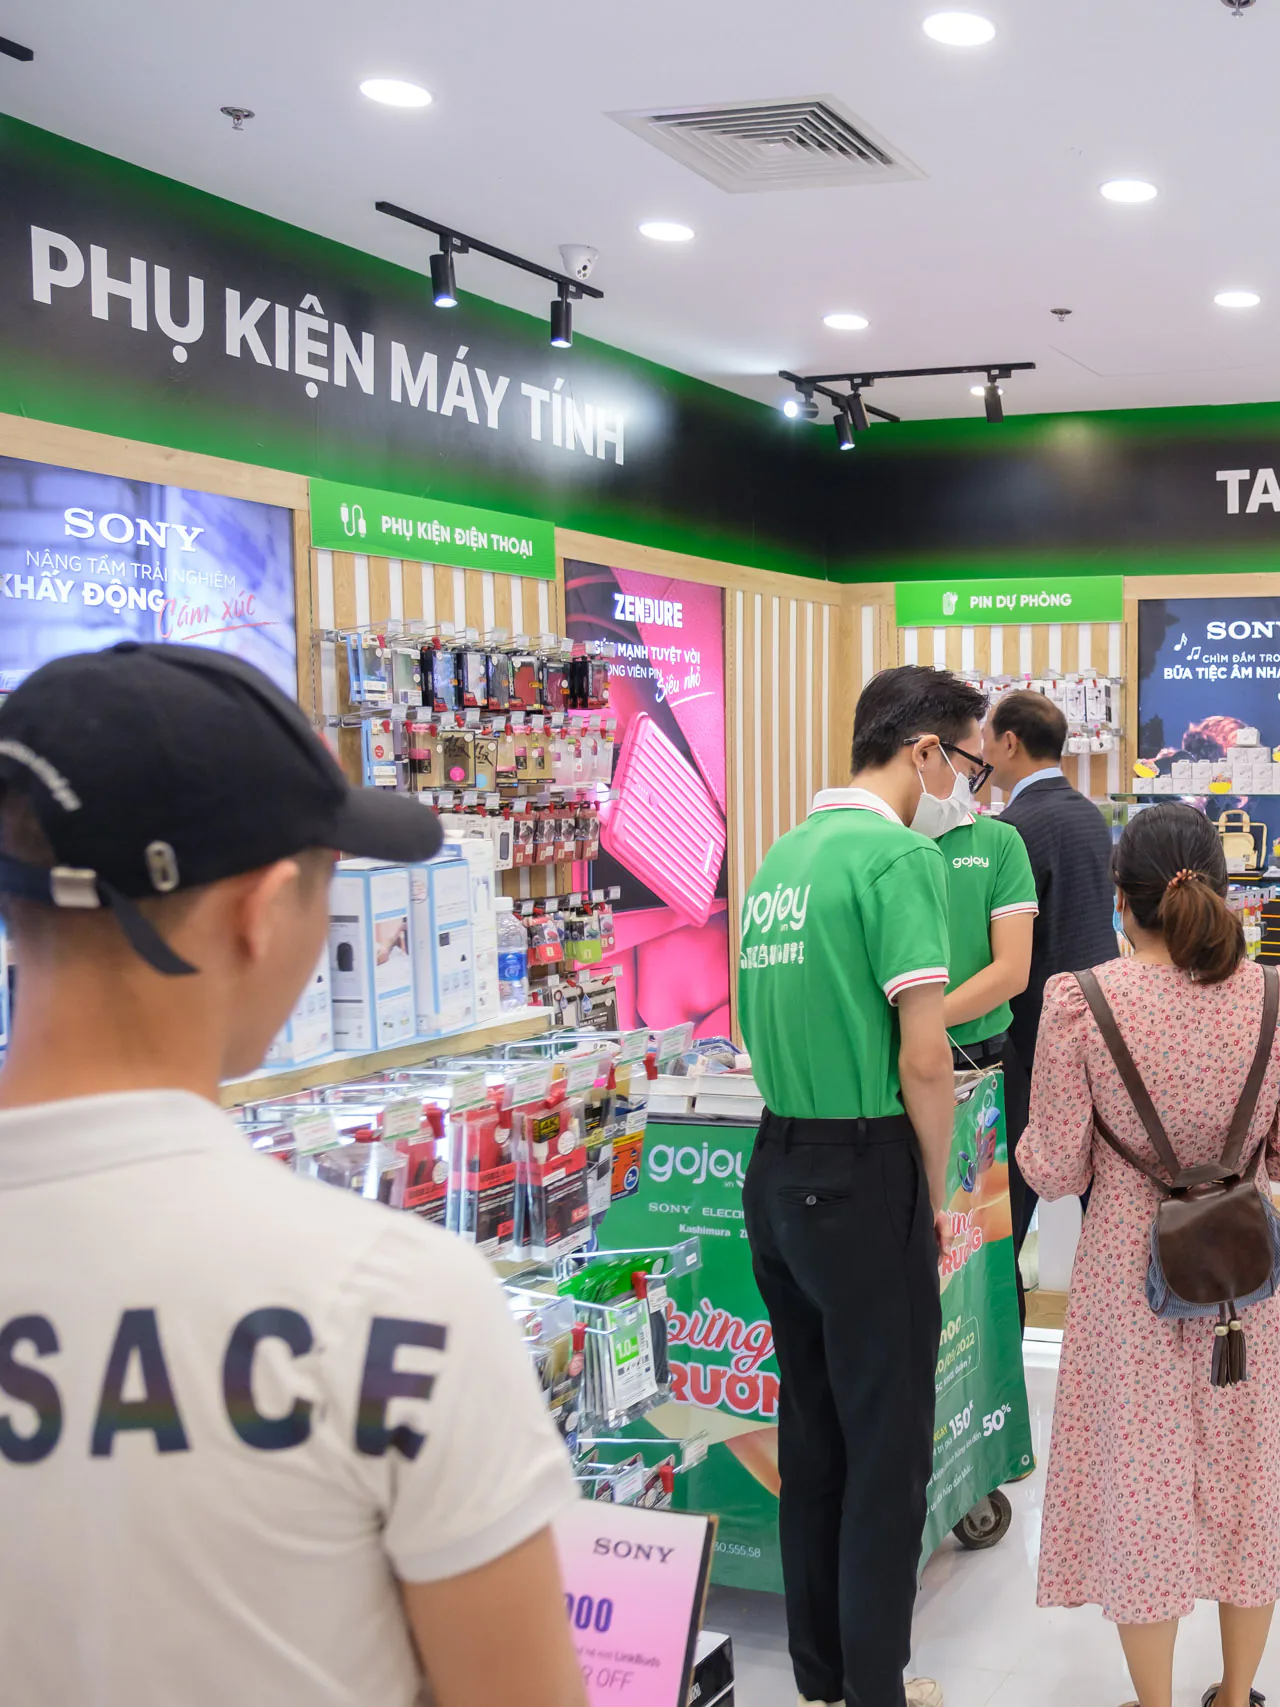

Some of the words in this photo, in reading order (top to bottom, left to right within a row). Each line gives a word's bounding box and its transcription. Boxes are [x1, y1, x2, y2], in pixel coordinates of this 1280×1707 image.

[31, 224, 204, 364] PHỤ
[225, 286, 375, 398] KIỆN
[390, 341, 510, 430] MÁY
[521, 376, 625, 466] TÍNH
[64, 507, 204, 552] SONY
[381, 515, 413, 541] PHỤ
[417, 520, 450, 545] KIỆN
[454, 526, 488, 551] ĐIỆN
[490, 534, 533, 559] THOẠI
[26, 549, 82, 572] NÂNG
[87, 554, 126, 577] TẦM
[130, 561, 169, 582] TRẢI
[173, 569, 236, 591] NGHIỆM
[82, 579, 165, 614] ĐỘNG
[969, 595, 992, 609] PIN
[996, 594, 1016, 611] DỰ
[1020, 590, 1072, 608] PHÒNG
[613, 593, 683, 628] ZENDURE
[617, 643, 648, 661] MẠNH
[650, 645, 681, 665] TUYỆT
[1202, 653, 1228, 663] CHÌM
[608, 664, 625, 677] ONG
[628, 664, 647, 678] VIÊN
[648, 667, 662, 679] PIN
[1164, 664, 1192, 679] BỮA
[1196, 664, 1227, 682] TIỆC
[1231, 664, 1252, 679] ÂM
[952, 855, 989, 869] gojoy
[648, 1202, 691, 1214] SONY
[679, 1223, 731, 1237] Kashimura
[593, 1537, 675, 1564] SONY
[597, 1667, 635, 1691] OFF
